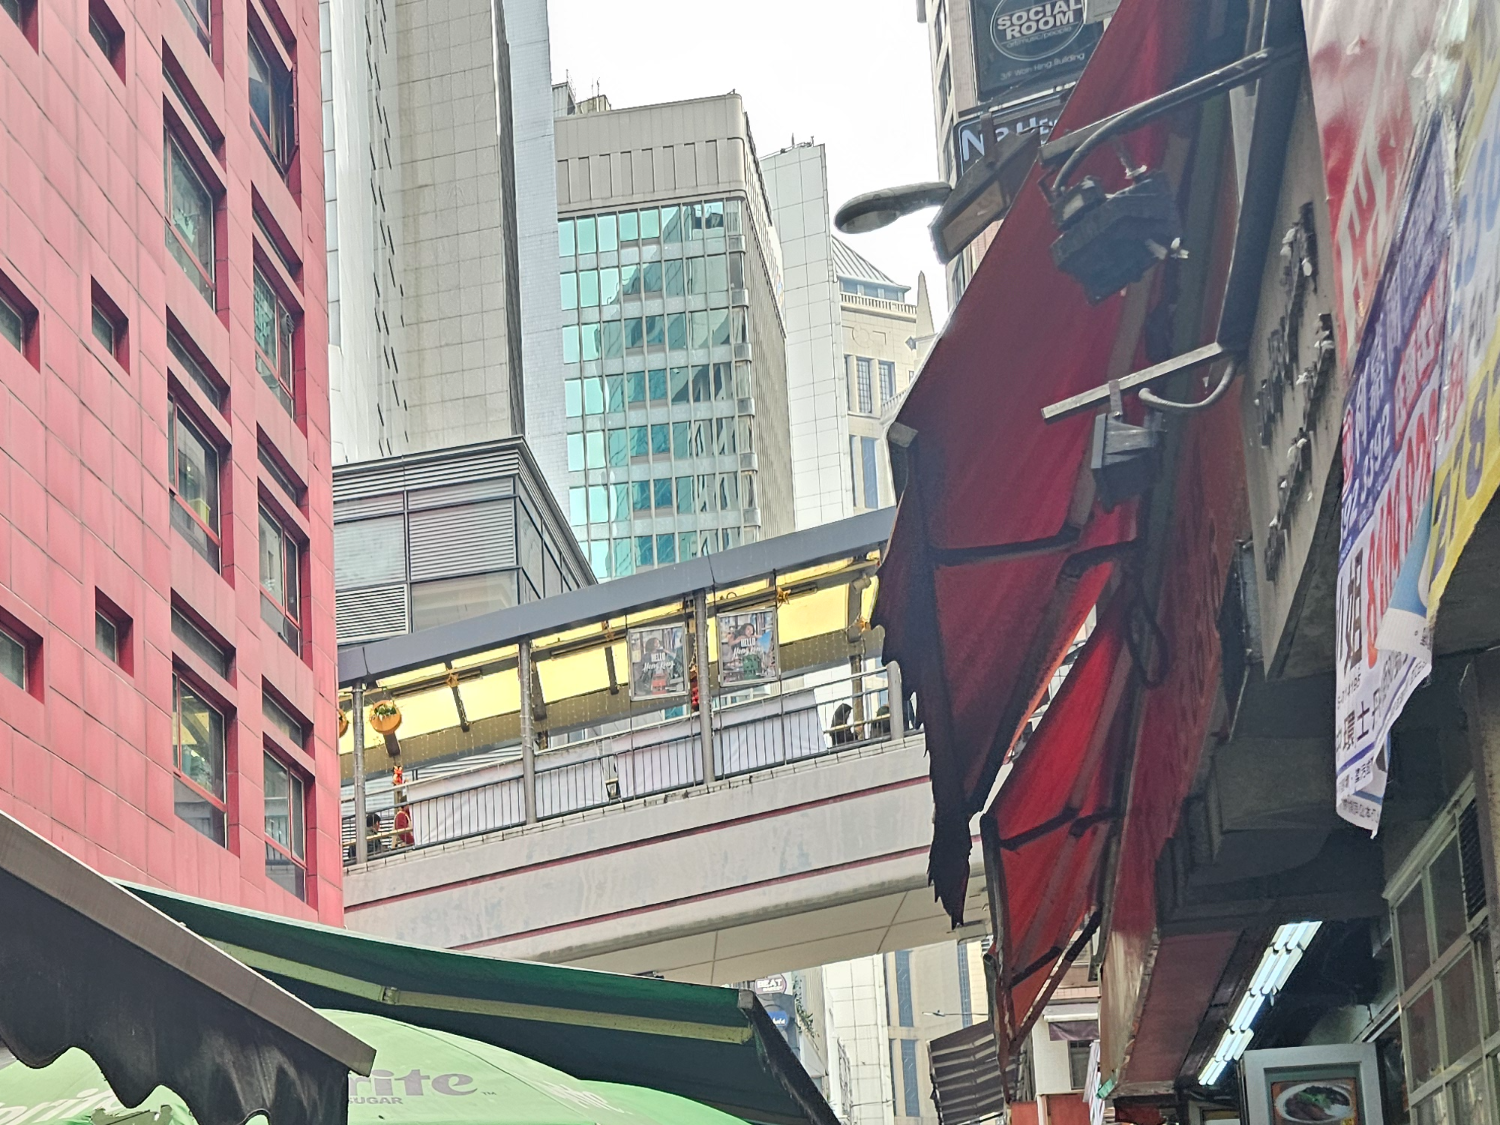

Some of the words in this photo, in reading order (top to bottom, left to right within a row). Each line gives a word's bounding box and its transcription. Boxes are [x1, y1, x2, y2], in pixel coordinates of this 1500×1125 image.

[997, 0, 1083, 30] SOCIAL
[1005, 10, 1074, 40] ROOM
[1053, 52, 1085, 68] Building
[741, 638, 756, 647] HELLO
[651, 653, 666, 662] HELLO
[349, 1069, 478, 1097] rite
